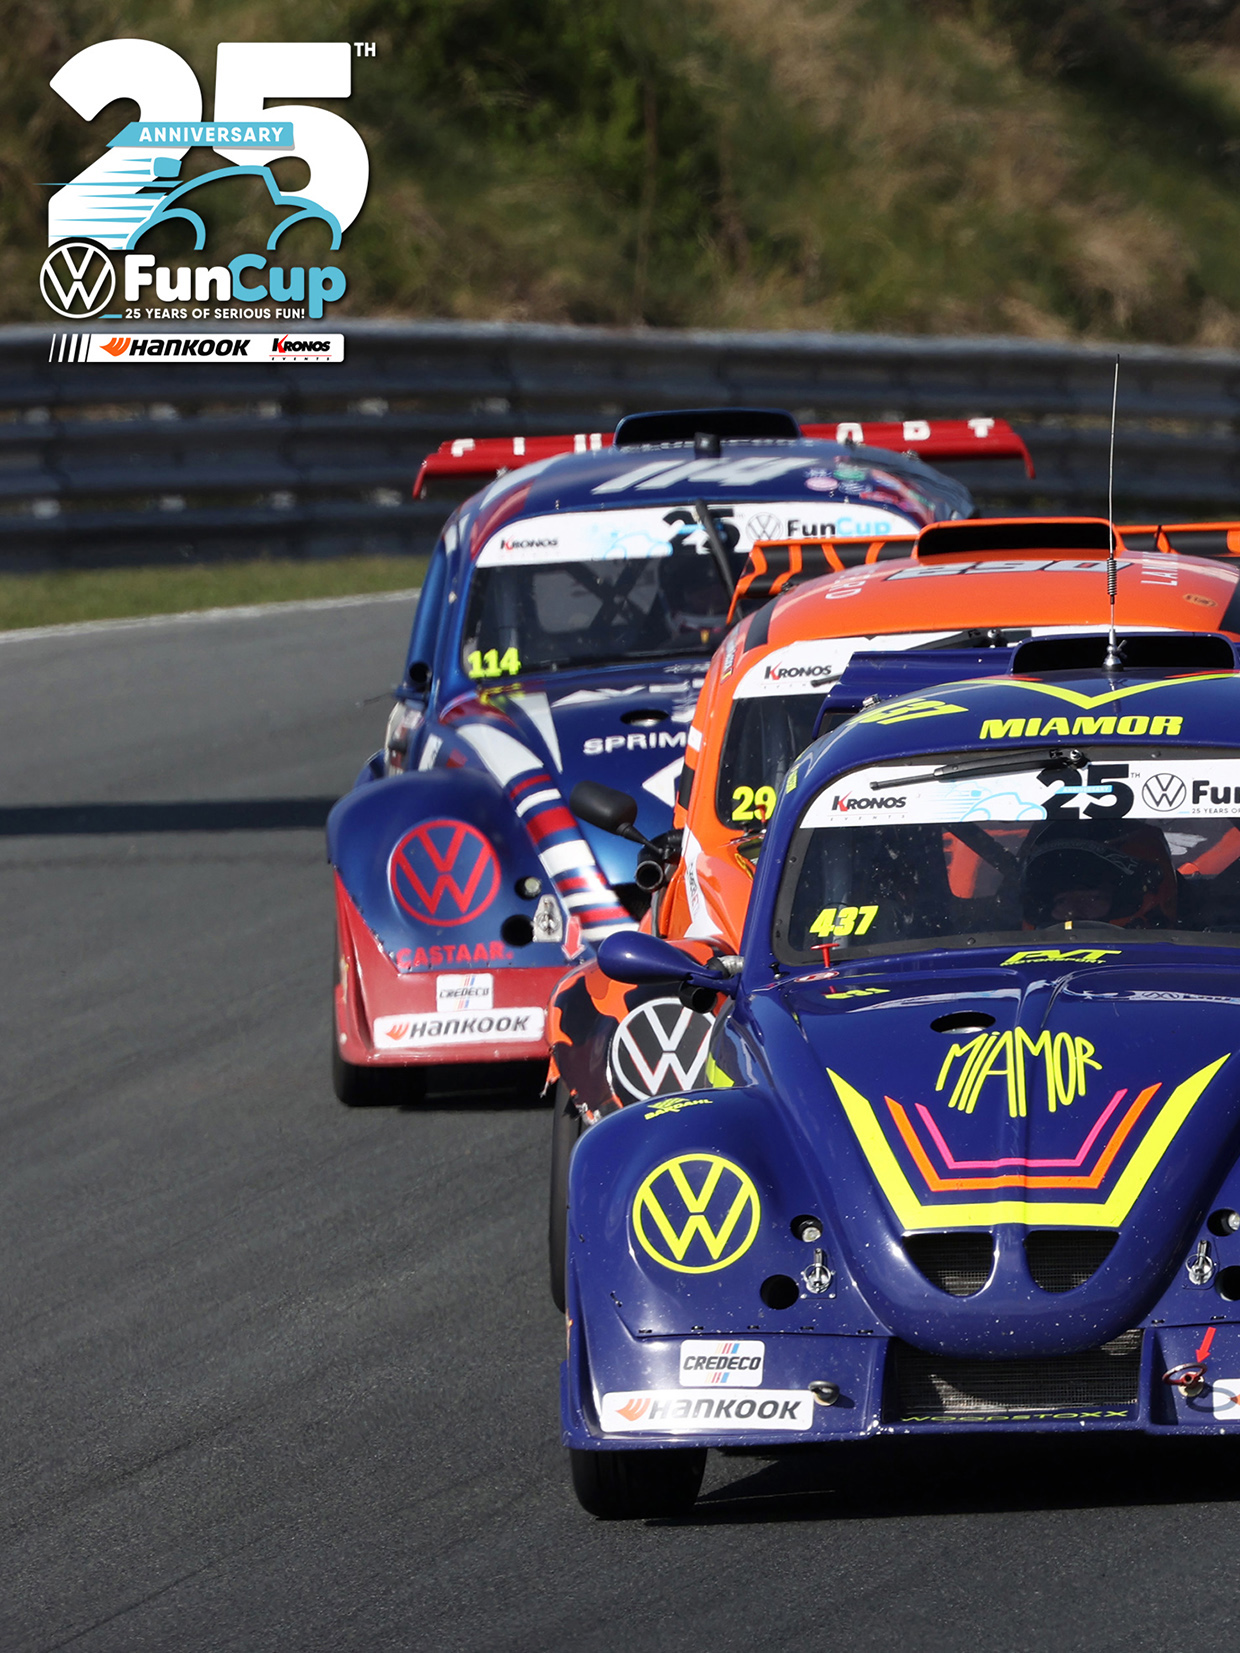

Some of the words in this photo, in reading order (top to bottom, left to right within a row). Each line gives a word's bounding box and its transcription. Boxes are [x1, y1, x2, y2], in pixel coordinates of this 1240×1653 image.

[467, 647, 521, 678] 114
[764, 662, 832, 681] KRONOS
[980, 715, 1183, 740] MIAMOR
[832, 791, 907, 812] KRONOS
[1036, 764, 1135, 819] 25
[809, 905, 879, 937] 437
[683, 1356, 761, 1371] CREDECO
